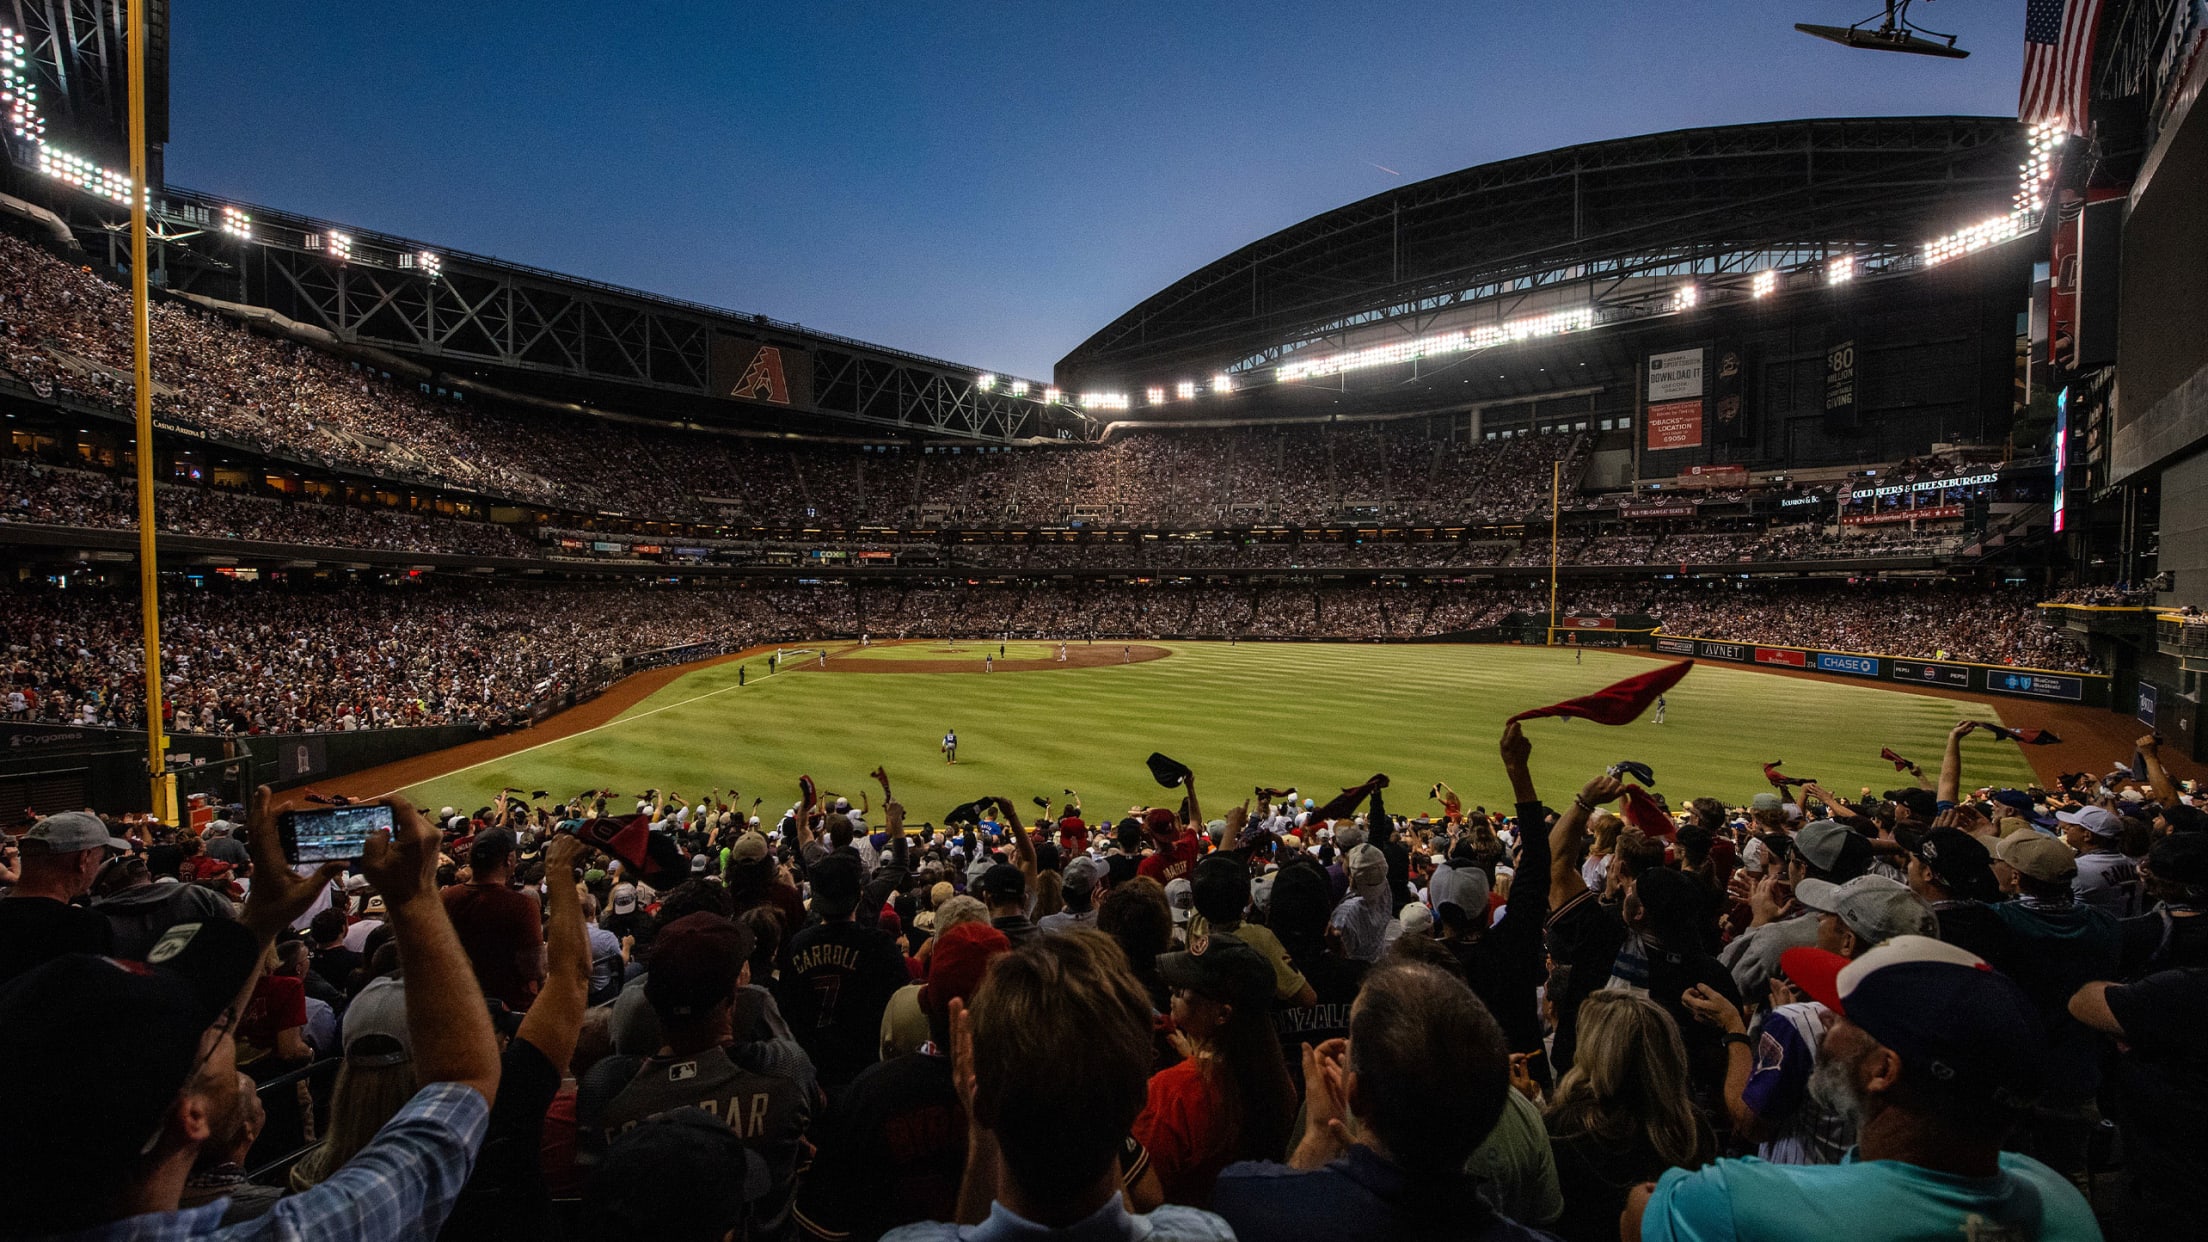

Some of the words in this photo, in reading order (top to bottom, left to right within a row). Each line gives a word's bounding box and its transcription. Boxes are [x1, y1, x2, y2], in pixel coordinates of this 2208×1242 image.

[1827, 347, 1854, 372] $80
[1651, 369, 1691, 384] DOWNLOAD
[1693, 368, 1701, 379] IT
[1827, 368, 1854, 384] MILLION
[1826, 392, 1853, 410] GIVING
[152, 419, 175, 431] CASINO
[175, 426, 199, 437] ARIZONA
[1658, 423, 1692, 432] LOCATION
[1852, 489, 1874, 499] COLD
[1876, 485, 1904, 498] BEERS
[1904, 483, 1911, 493] &
[1912, 473, 1998, 491] CHEESEBURGERS
[1705, 644, 1740, 658] AVNET
[1806, 661, 1816, 669] 374
[1824, 657, 1858, 670] CHASE
[1950, 672, 1967, 680] PEPSI
[22, 732, 83, 744] Cygames
[792, 943, 860, 975] CARROLL
[810, 975, 841, 1029] 7
